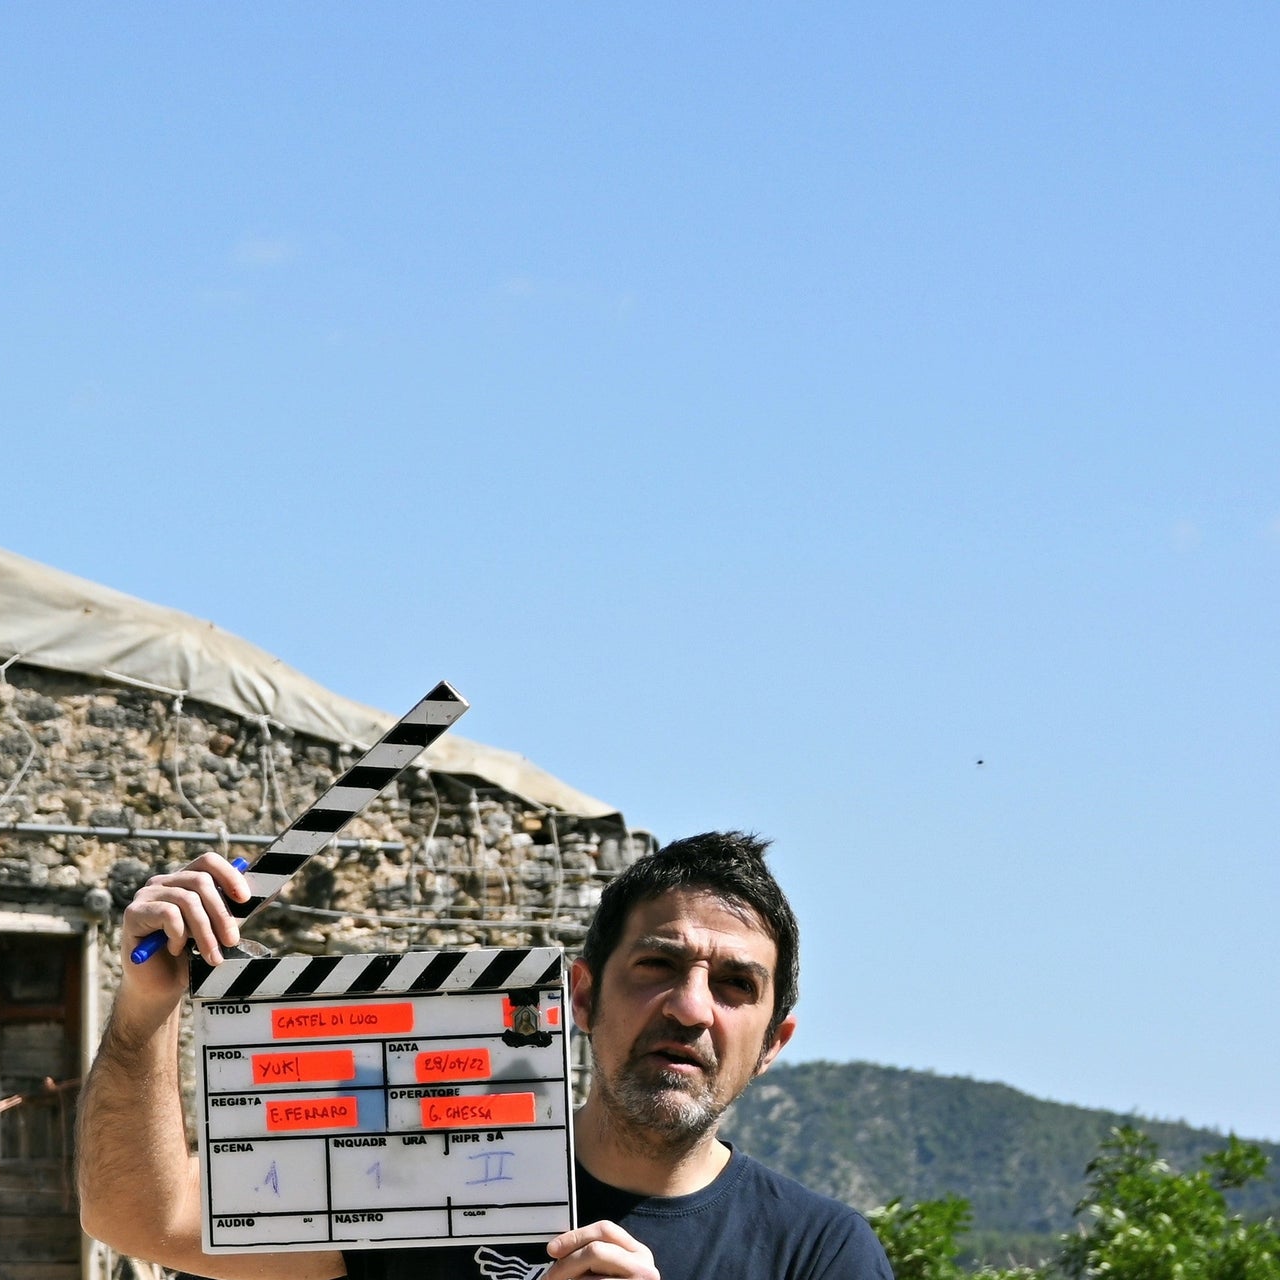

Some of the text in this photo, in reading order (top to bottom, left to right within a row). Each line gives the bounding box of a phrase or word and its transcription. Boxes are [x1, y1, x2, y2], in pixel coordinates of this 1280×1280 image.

[208, 1005, 250, 1015] TITOLO
[278, 1014, 326, 1029] CASTEL
[331, 1014, 343, 1025] DI
[389, 1043, 419, 1052] DATA
[390, 1088, 460, 1099] OPERATORE
[211, 1098, 261, 1107] REGISTA
[446, 1106, 491, 1120] CHESSA
[214, 1143, 254, 1153] SCENA
[217, 1218, 255, 1228] AUDIO
[335, 1213, 383, 1224] NASTRO
